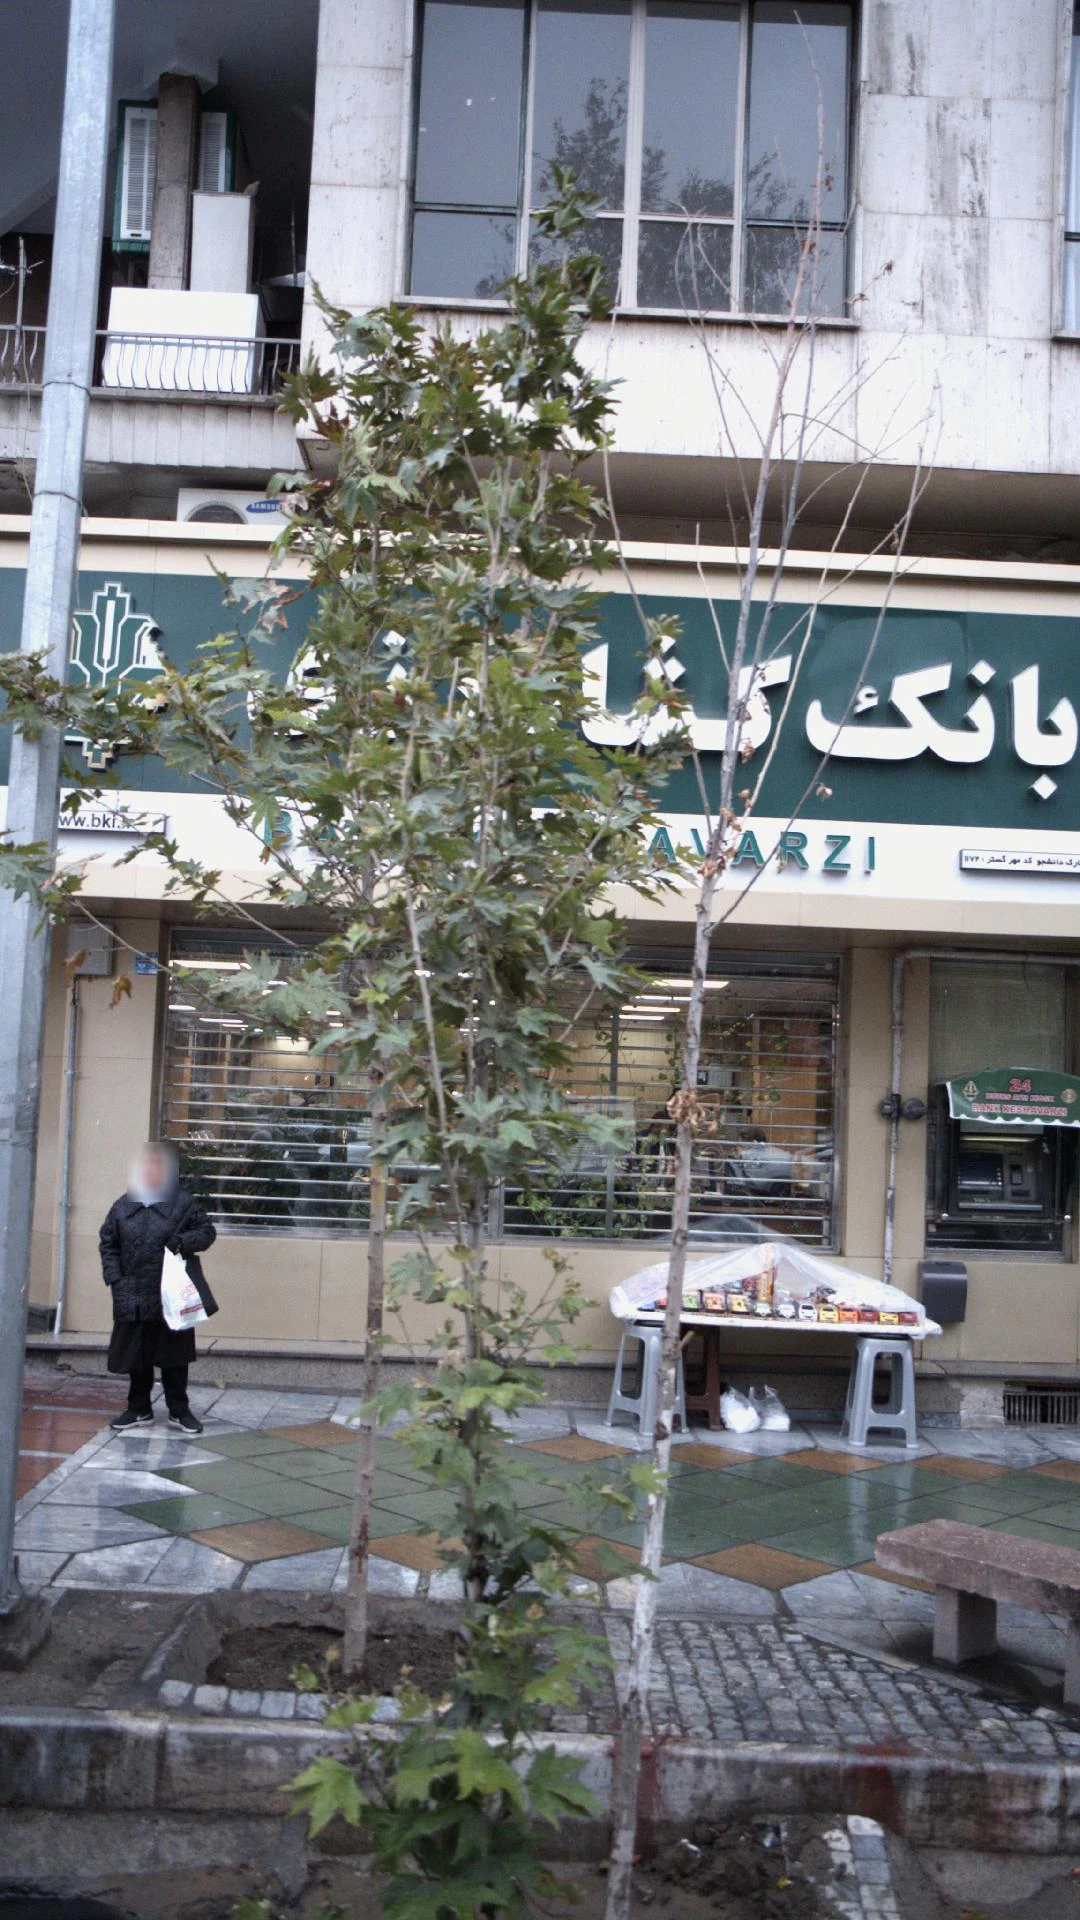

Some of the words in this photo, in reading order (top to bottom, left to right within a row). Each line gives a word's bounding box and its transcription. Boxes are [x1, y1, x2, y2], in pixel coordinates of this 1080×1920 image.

[805, 660, 1079, 800] بانک
[1009, 1078, 1032, 1093] 24
[971, 1103, 1001, 1113] BANK
